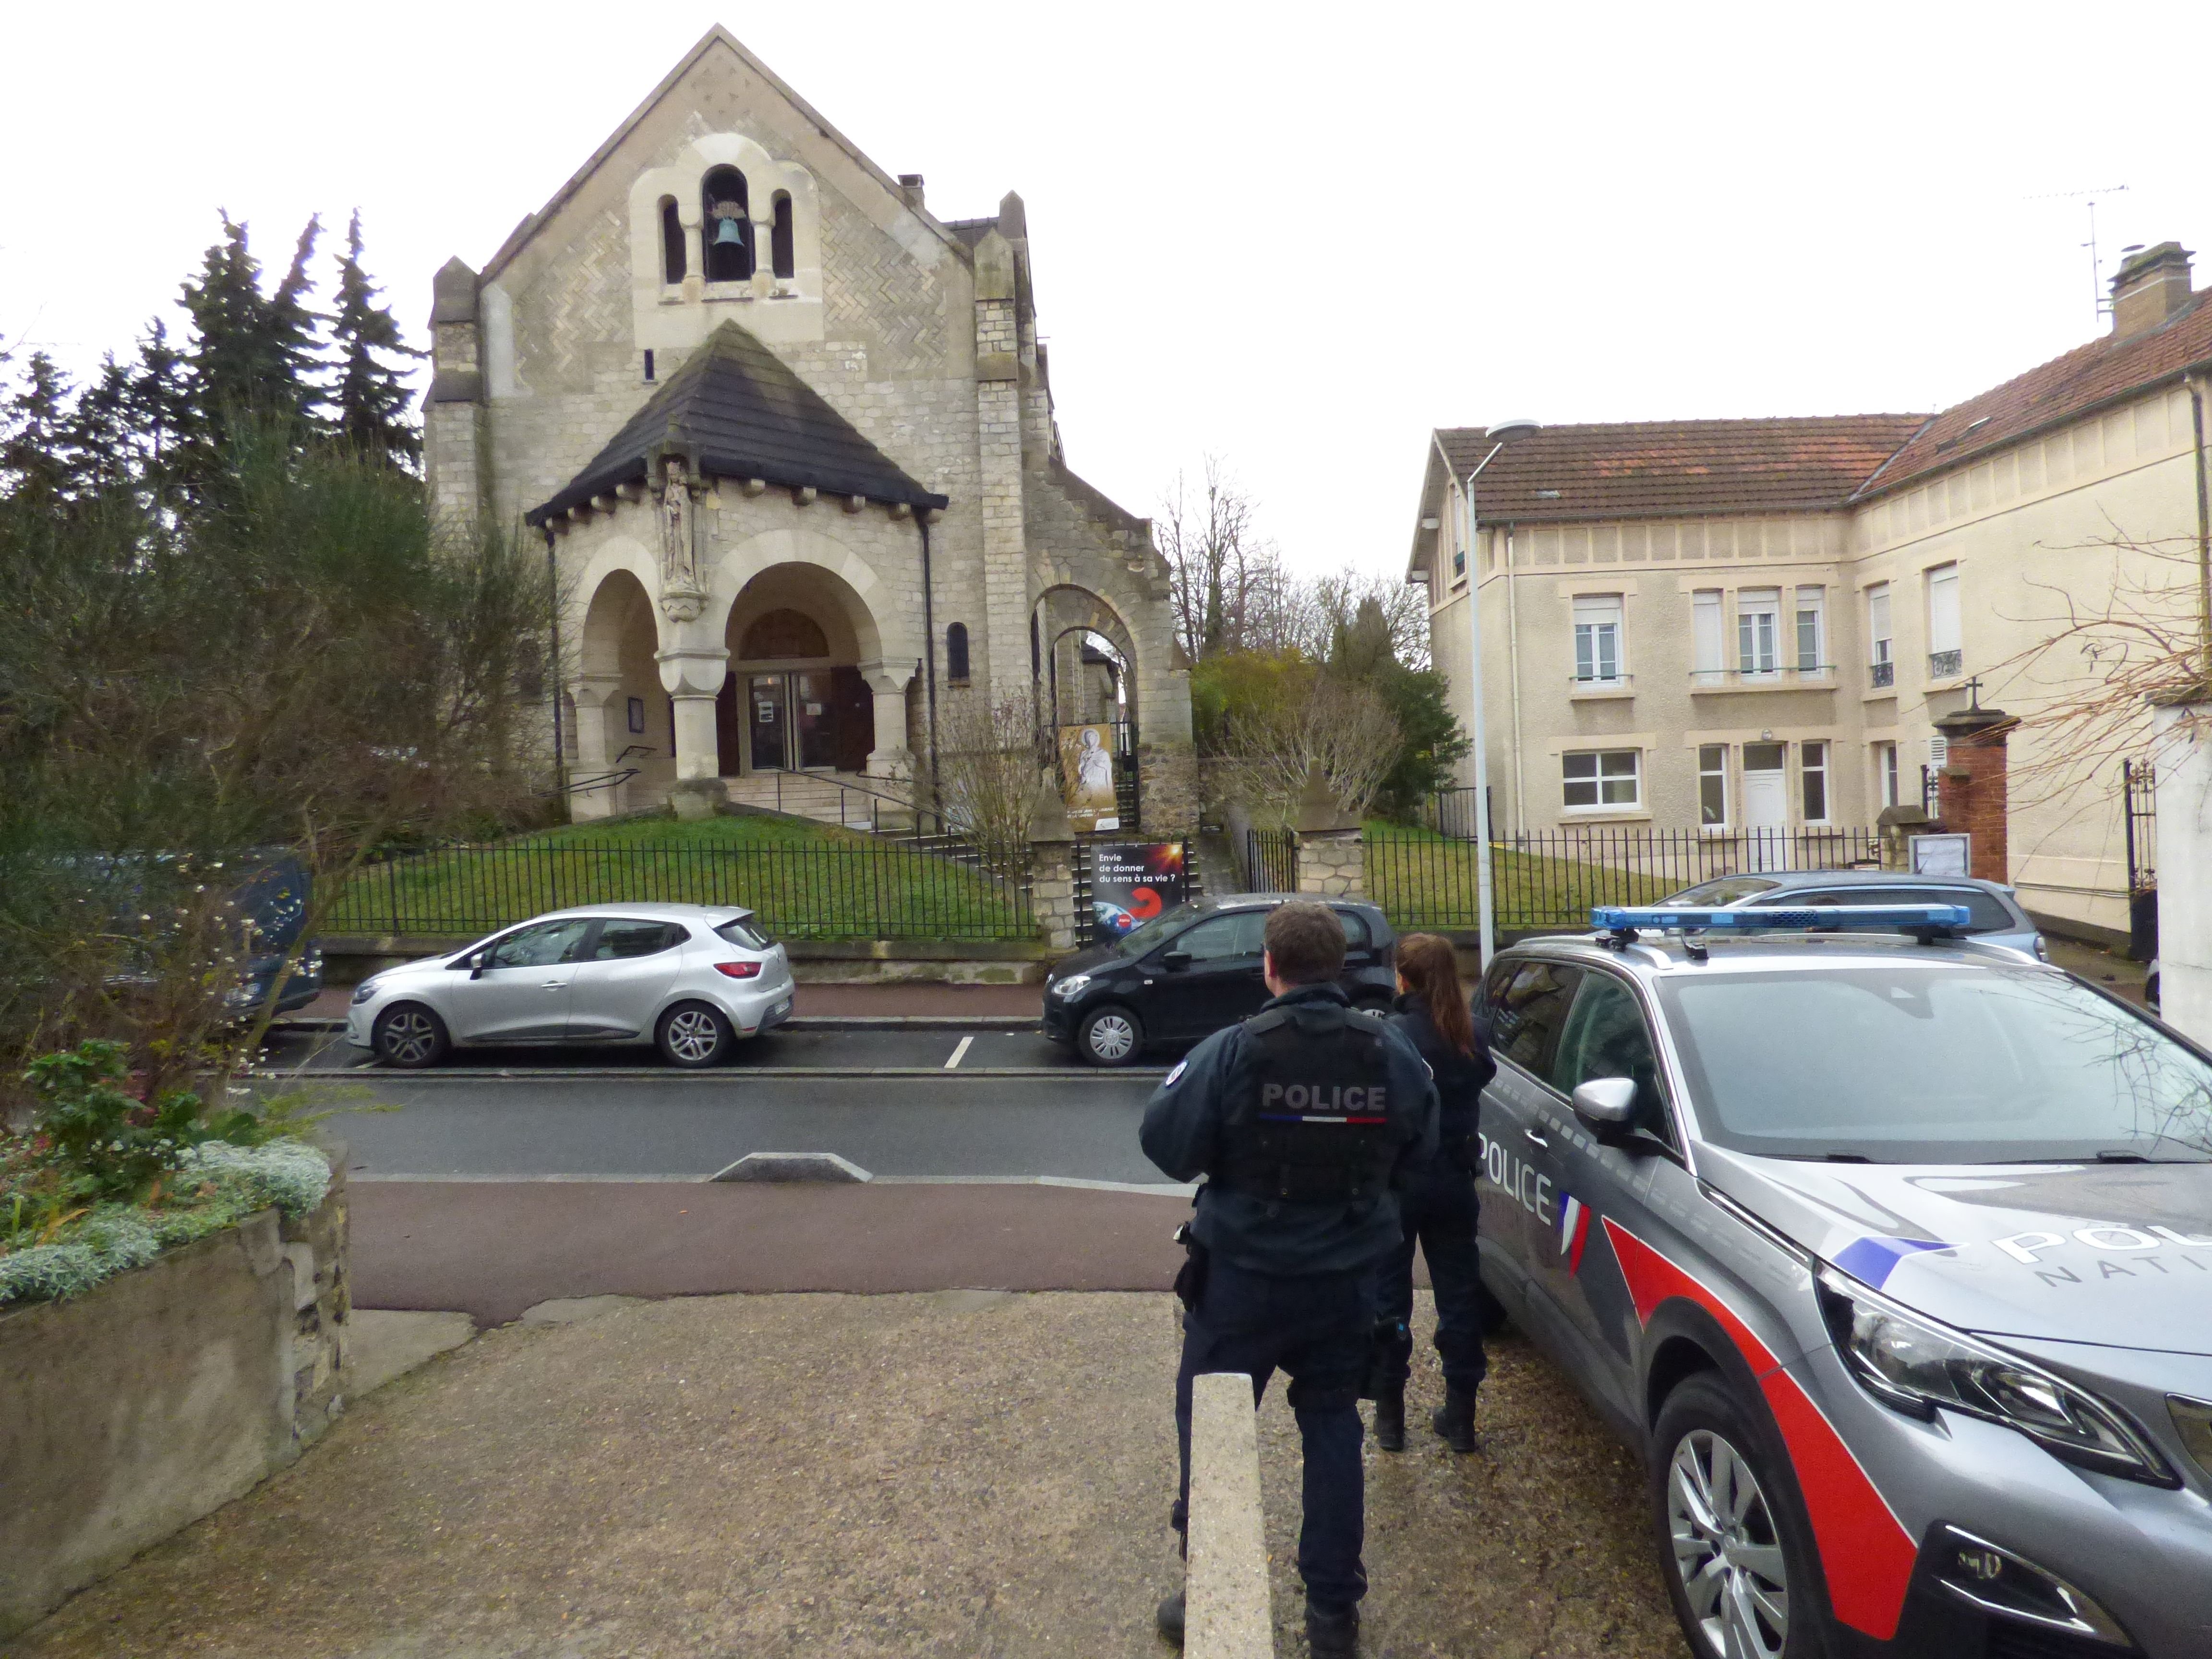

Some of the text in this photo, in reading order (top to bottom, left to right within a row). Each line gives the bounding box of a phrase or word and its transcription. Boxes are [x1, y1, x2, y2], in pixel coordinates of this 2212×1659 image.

[1099, 854, 1122, 862] Envie
[1113, 864, 1144, 872] donner
[1134, 874, 1140, 882] à
[1155, 874, 1168, 882] vie
[1170, 874, 1176, 882] ?
[1261, 1083, 1386, 1111] POLICE
[2034, 1254, 2208, 1288] NATI
